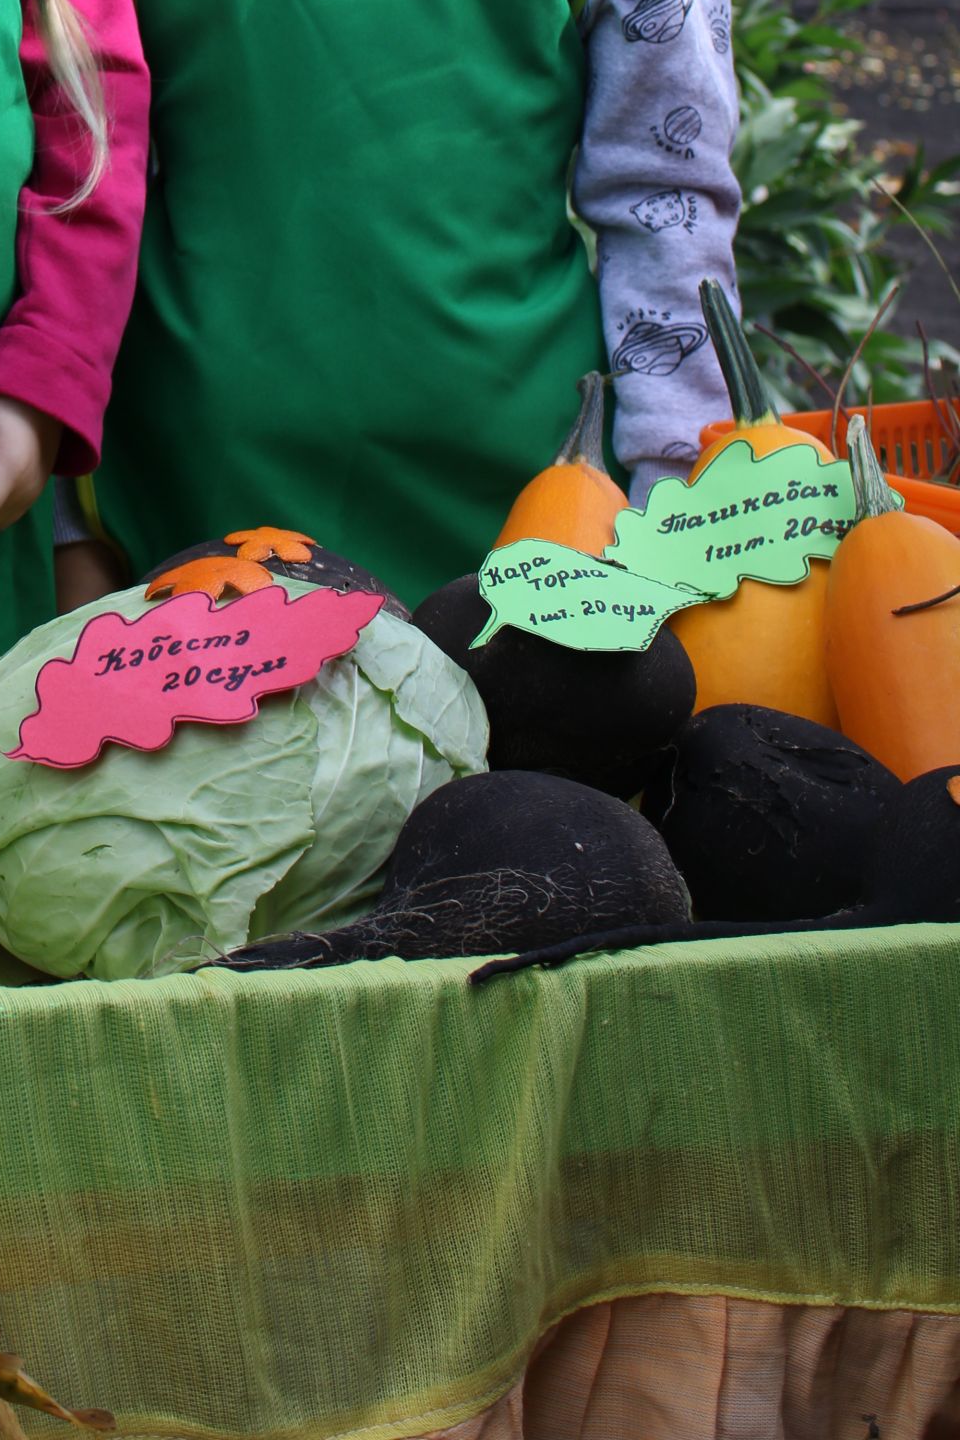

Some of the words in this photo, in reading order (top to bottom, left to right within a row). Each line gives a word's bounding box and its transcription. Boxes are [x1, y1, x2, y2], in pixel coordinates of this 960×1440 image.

[683, 196, 698, 235] Moon
[657, 480, 839, 534] Ташкабак
[484, 556, 551, 588] Кара
[581, 600, 607, 616] 20
[612, 605, 657, 623] сум
[95, 630, 250, 677] Кәбестә
